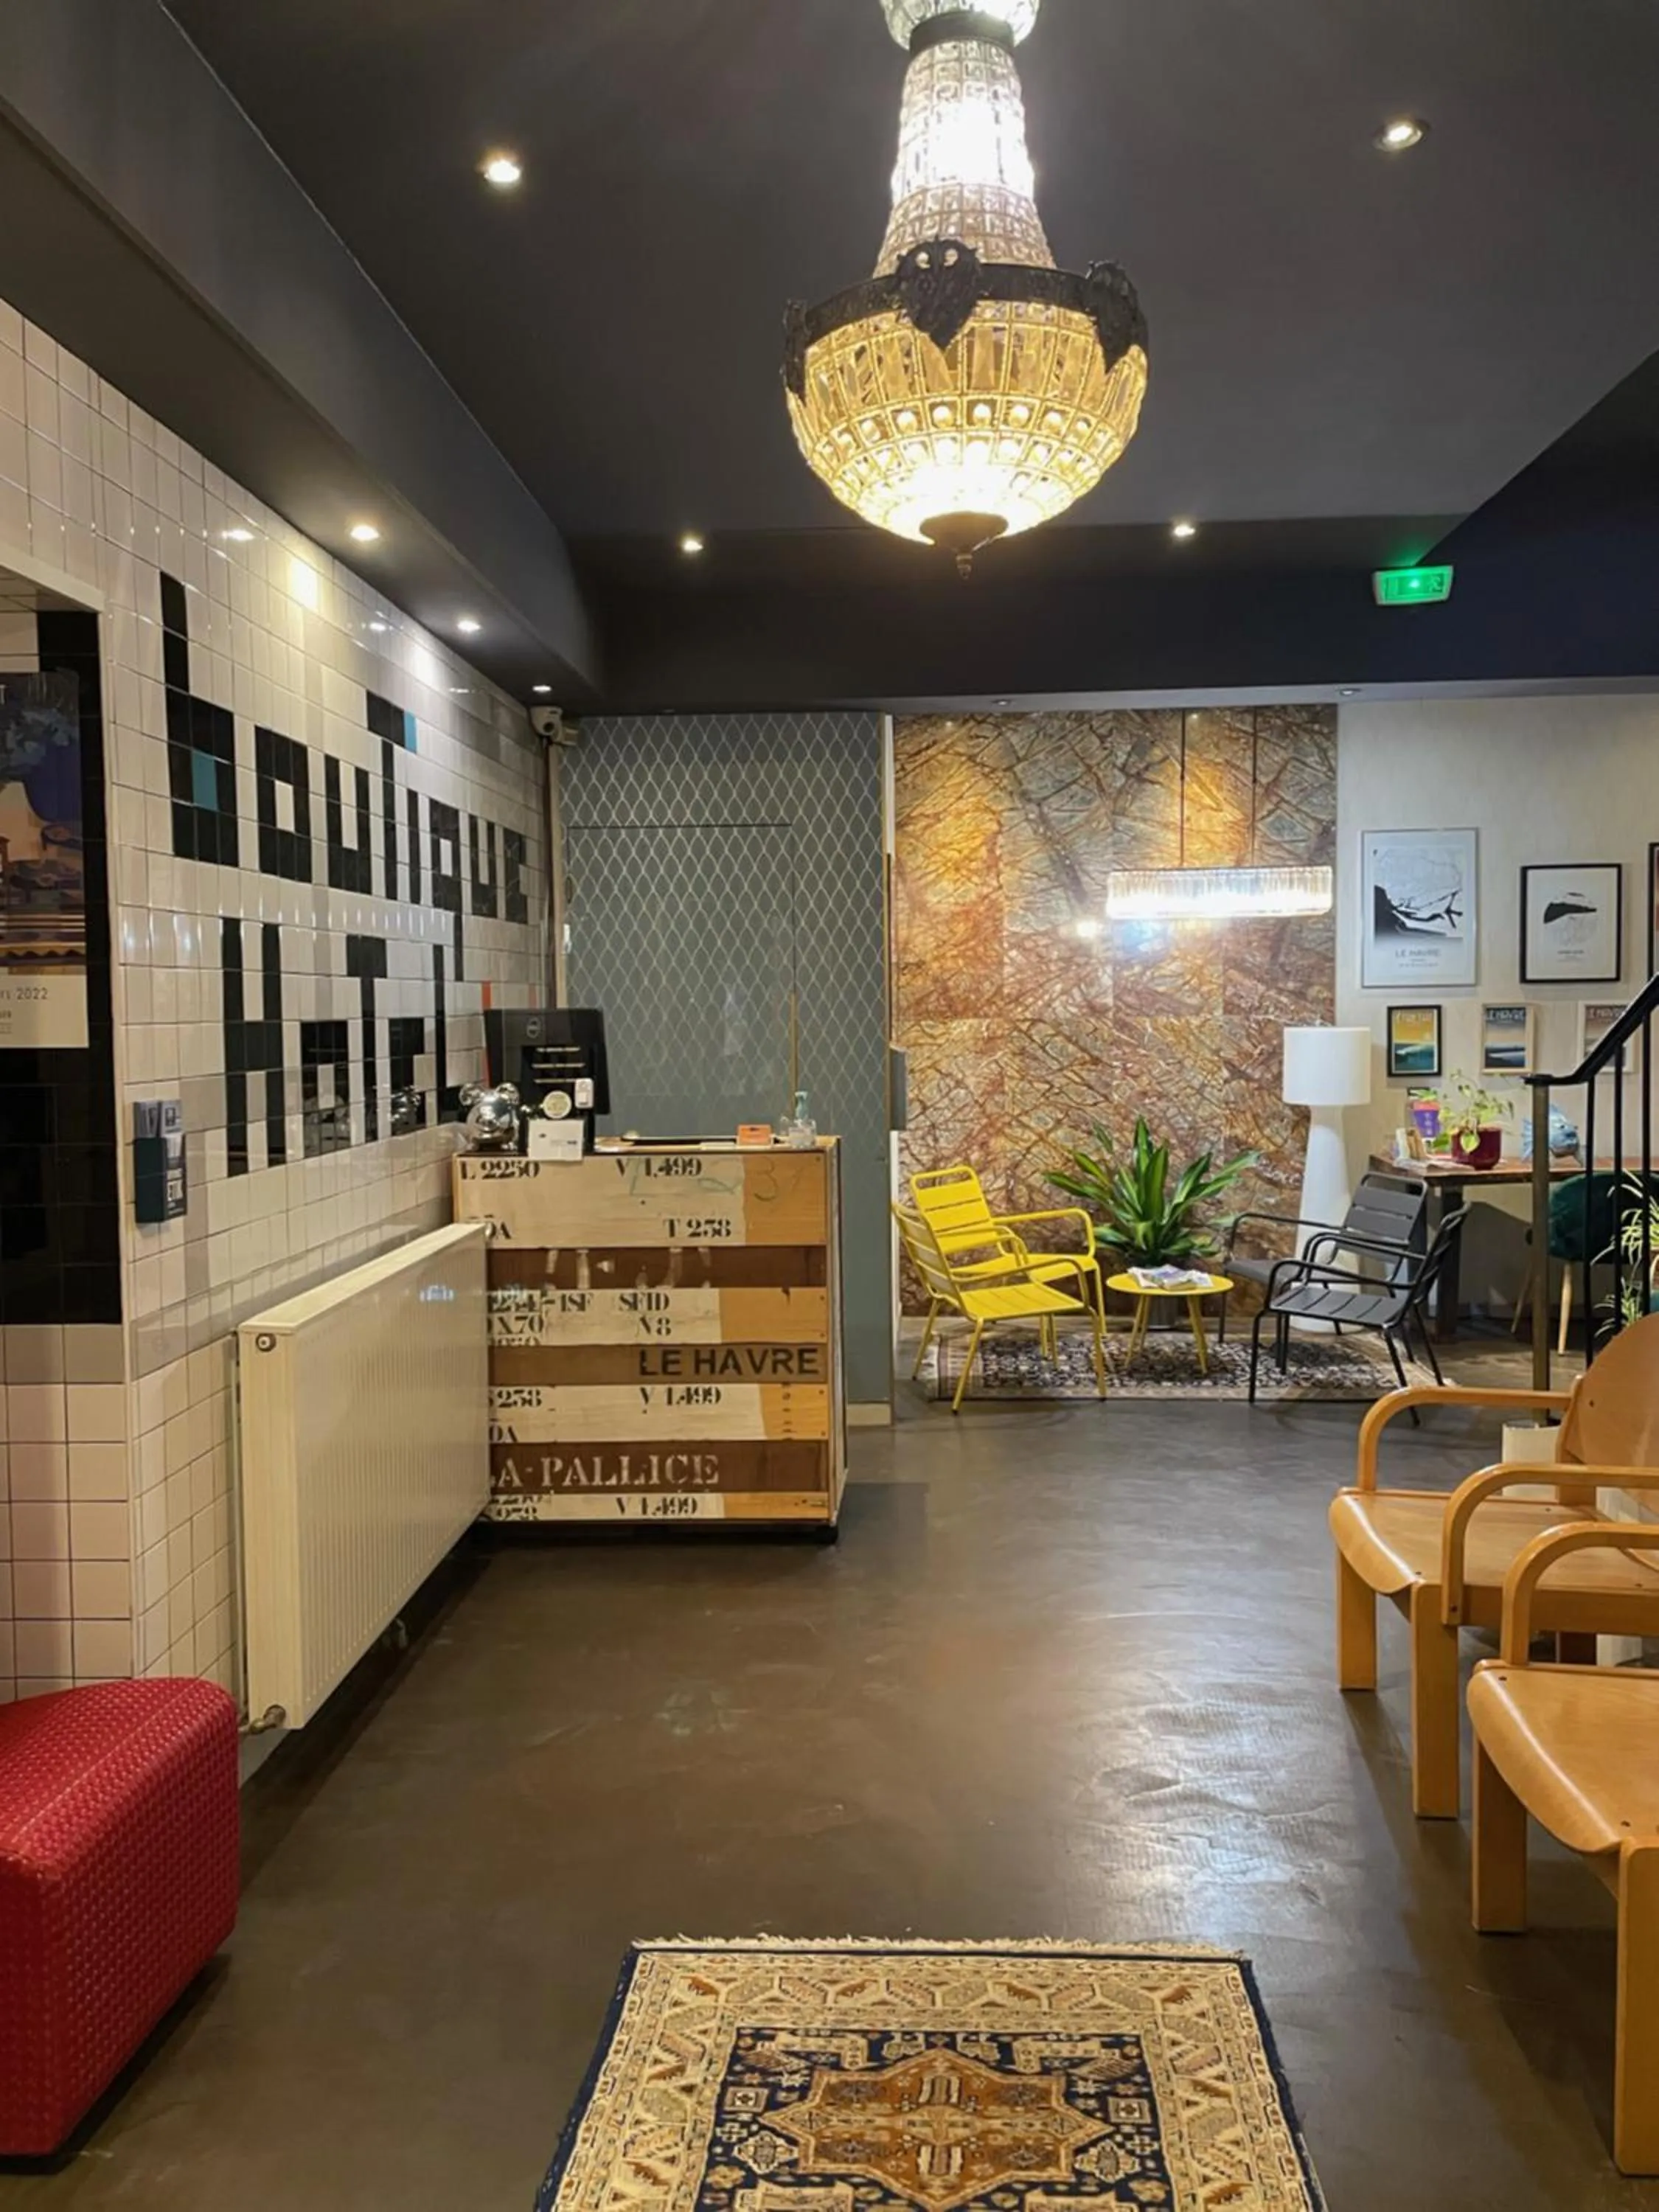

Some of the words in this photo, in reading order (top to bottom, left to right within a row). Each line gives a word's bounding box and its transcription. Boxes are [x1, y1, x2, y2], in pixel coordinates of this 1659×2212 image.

[16, 987, 48, 1001] 2022
[481, 1160, 540, 1180] 2250
[615, 1158, 630, 1178] V
[663, 1218, 681, 1238] T
[639, 1349, 683, 1377] LE
[693, 1348, 820, 1376] HAVRE
[639, 1386, 654, 1405] V
[615, 1496, 630, 1516] V
